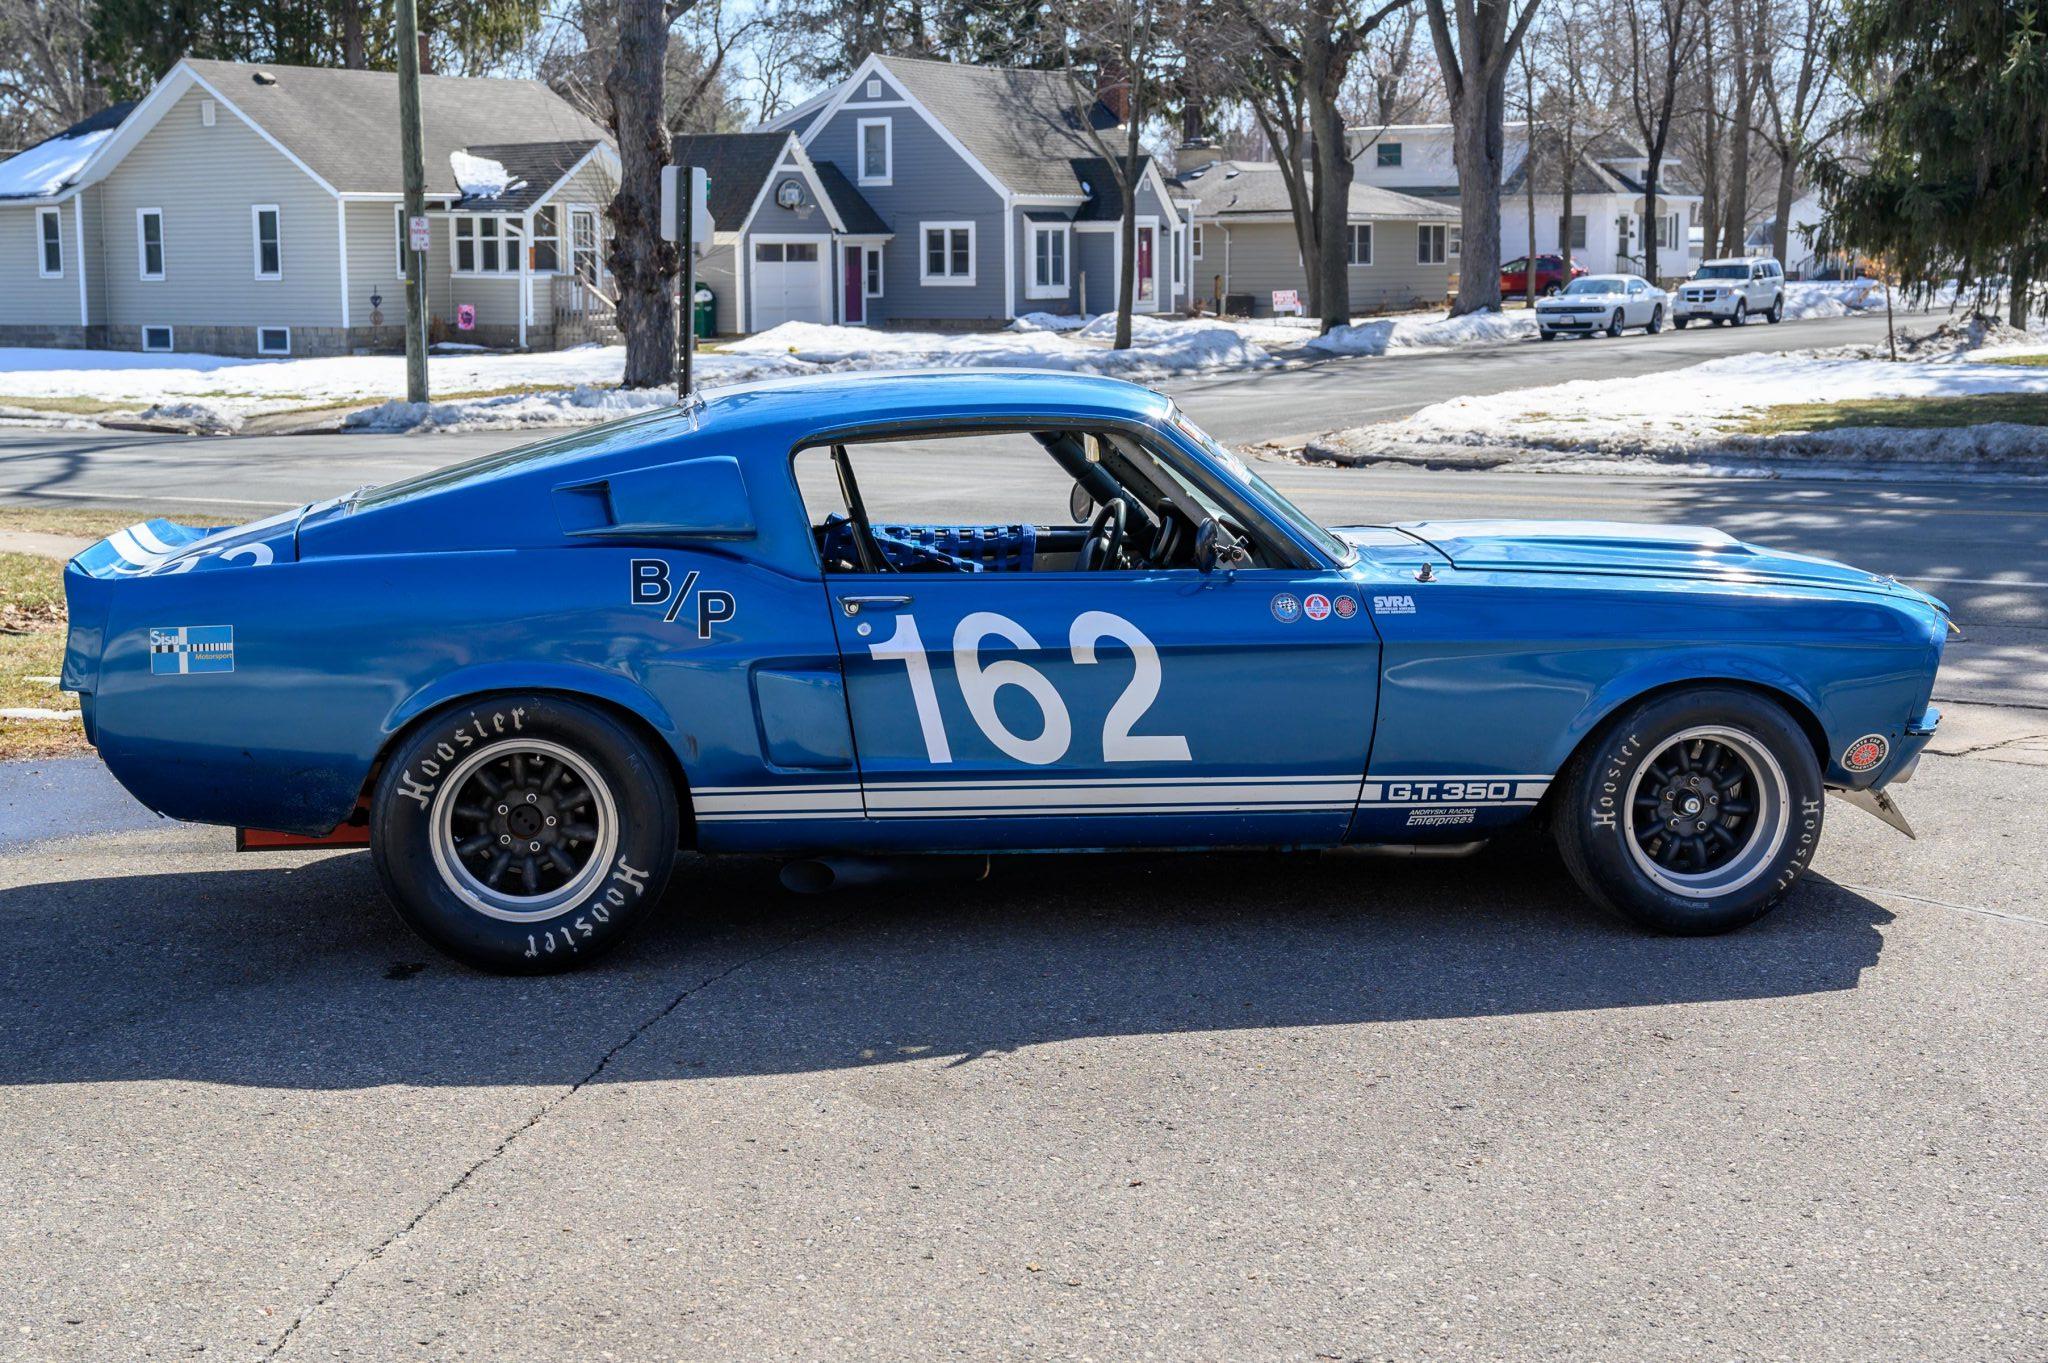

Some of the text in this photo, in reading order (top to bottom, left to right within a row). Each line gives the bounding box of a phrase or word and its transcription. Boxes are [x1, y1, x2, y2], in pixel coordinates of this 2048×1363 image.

[150, 630, 179, 645] Sisu
[630, 559, 736, 639] B/P
[1373, 595, 1415, 607] SVRA
[195, 652, 232, 661] Motorsport
[868, 610, 1193, 765] 162
[397, 707, 525, 810] Hoosier
[1591, 734, 1641, 831] Hoosier
[1847, 739, 1867, 757] SPORTS
[1406, 815, 1474, 826] Enterprises
[1777, 796, 1820, 890] Hoosier
[524, 854, 650, 958] Hoosier
